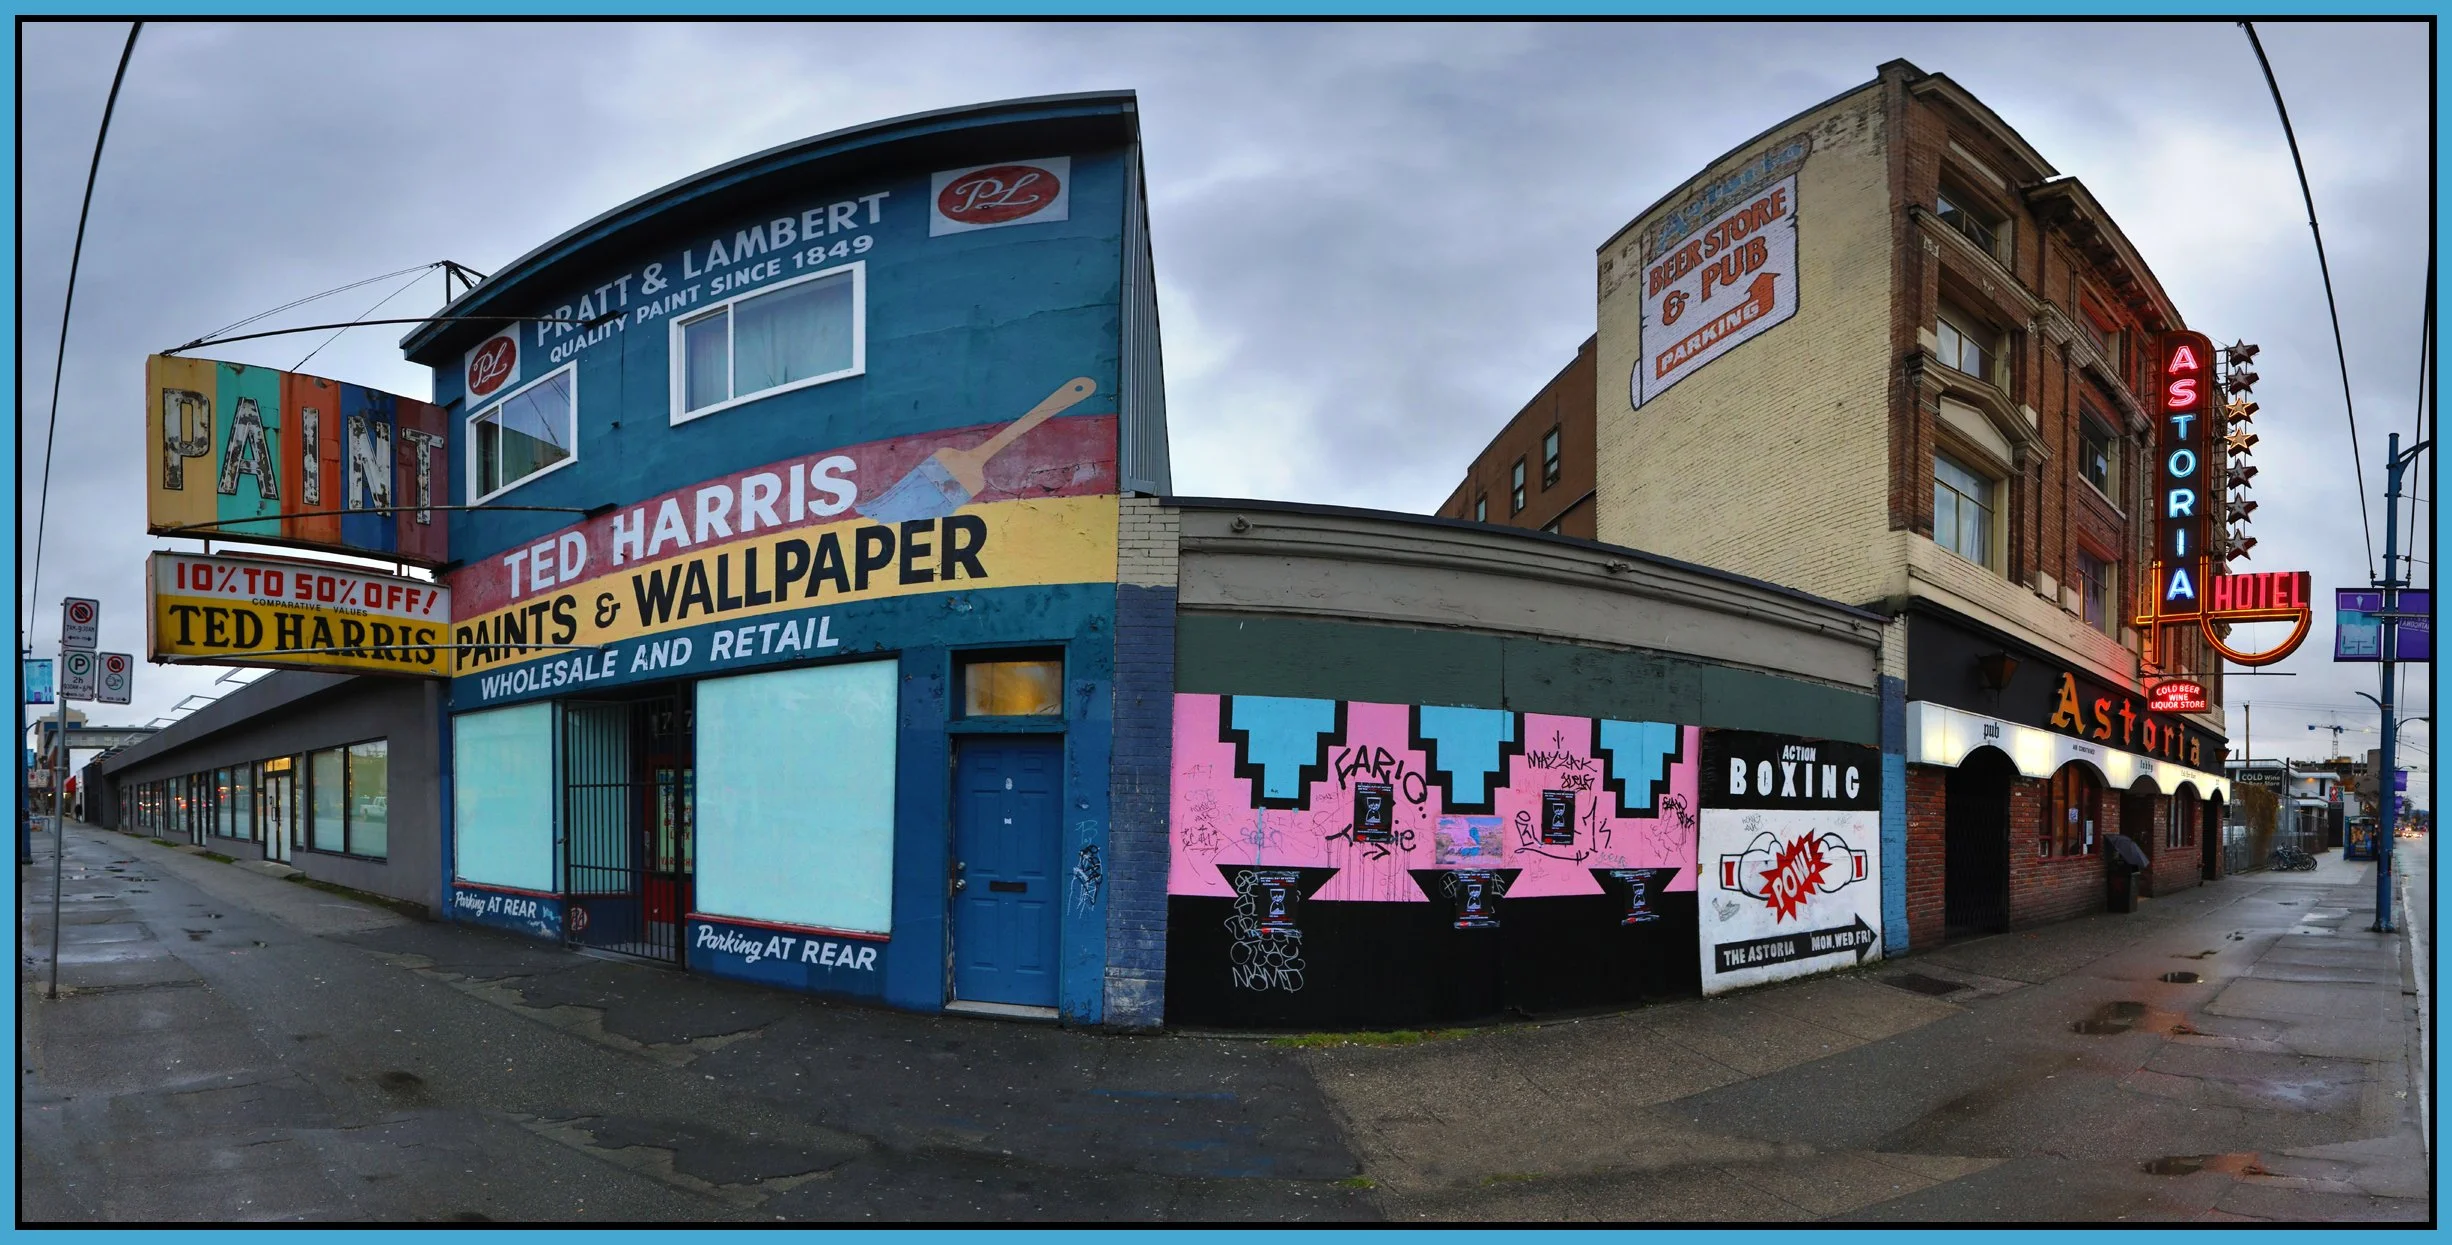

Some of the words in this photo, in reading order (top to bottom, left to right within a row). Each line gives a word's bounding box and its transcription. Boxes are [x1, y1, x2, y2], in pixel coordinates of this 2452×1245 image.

[537, 273, 632, 347] PRATT
[642, 261, 668, 296] &
[683, 191, 890, 281] LAMBERT
[1649, 239, 1704, 300] BEER
[1704, 187, 1787, 259] STORE
[549, 313, 627, 364] QUALITY
[636, 285, 700, 325] PAINT
[711, 257, 782, 297] SINCE
[792, 234, 875, 271] 1849
[1662, 290, 1689, 326] &
[1701, 236, 1768, 303] PUB
[1661, 300, 1760, 371] PARKING
[162, 387, 444, 526] PAINT
[2166, 344, 2199, 602] ASTORIA
[503, 530, 587, 600] TED
[611, 455, 859, 566] HARRIS
[243, 567, 284, 598] TO
[294, 573, 357, 606] 50%
[363, 582, 438, 616] OFF!
[252, 597, 322, 613] COMPARATIVE
[333, 605, 368, 617] VALUES
[456, 593, 577, 672] PAINTS
[594, 591, 621, 630] &
[632, 514, 989, 628] WALLPAPER
[2215, 571, 2308, 611] HOTEL
[169, 604, 264, 648] TED
[273, 612, 436, 667] HARRIS
[480, 649, 618, 701] WHOLESALE
[630, 635, 693, 674] AND
[709, 616, 840, 663] RETAIL
[2151, 701, 2179, 710] LIQUOR
[2180, 700, 2205, 709] STORE
[2156, 683, 2178, 696] COLD
[2179, 683, 2200, 695] BEER
[2168, 693, 2189, 702] WINE
[1983, 721, 2000, 741] pub
[2050, 671, 2201, 768] Astoria
[1730, 757, 1861, 799] BOXING
[1782, 744, 1817, 763] ACTION
[2241, 773, 2263, 781] COLD
[1772, 841, 1818, 911] POW!
[454, 890, 486, 917] Parking
[487, 895, 502, 913] AT
[503, 898, 538, 919] REAR
[696, 925, 763, 963] Parking
[763, 935, 797, 961] AT
[800, 939, 878, 972] REAR
[1723, 950, 1746, 967] THE
[1747, 940, 1796, 963] ASTORIA
